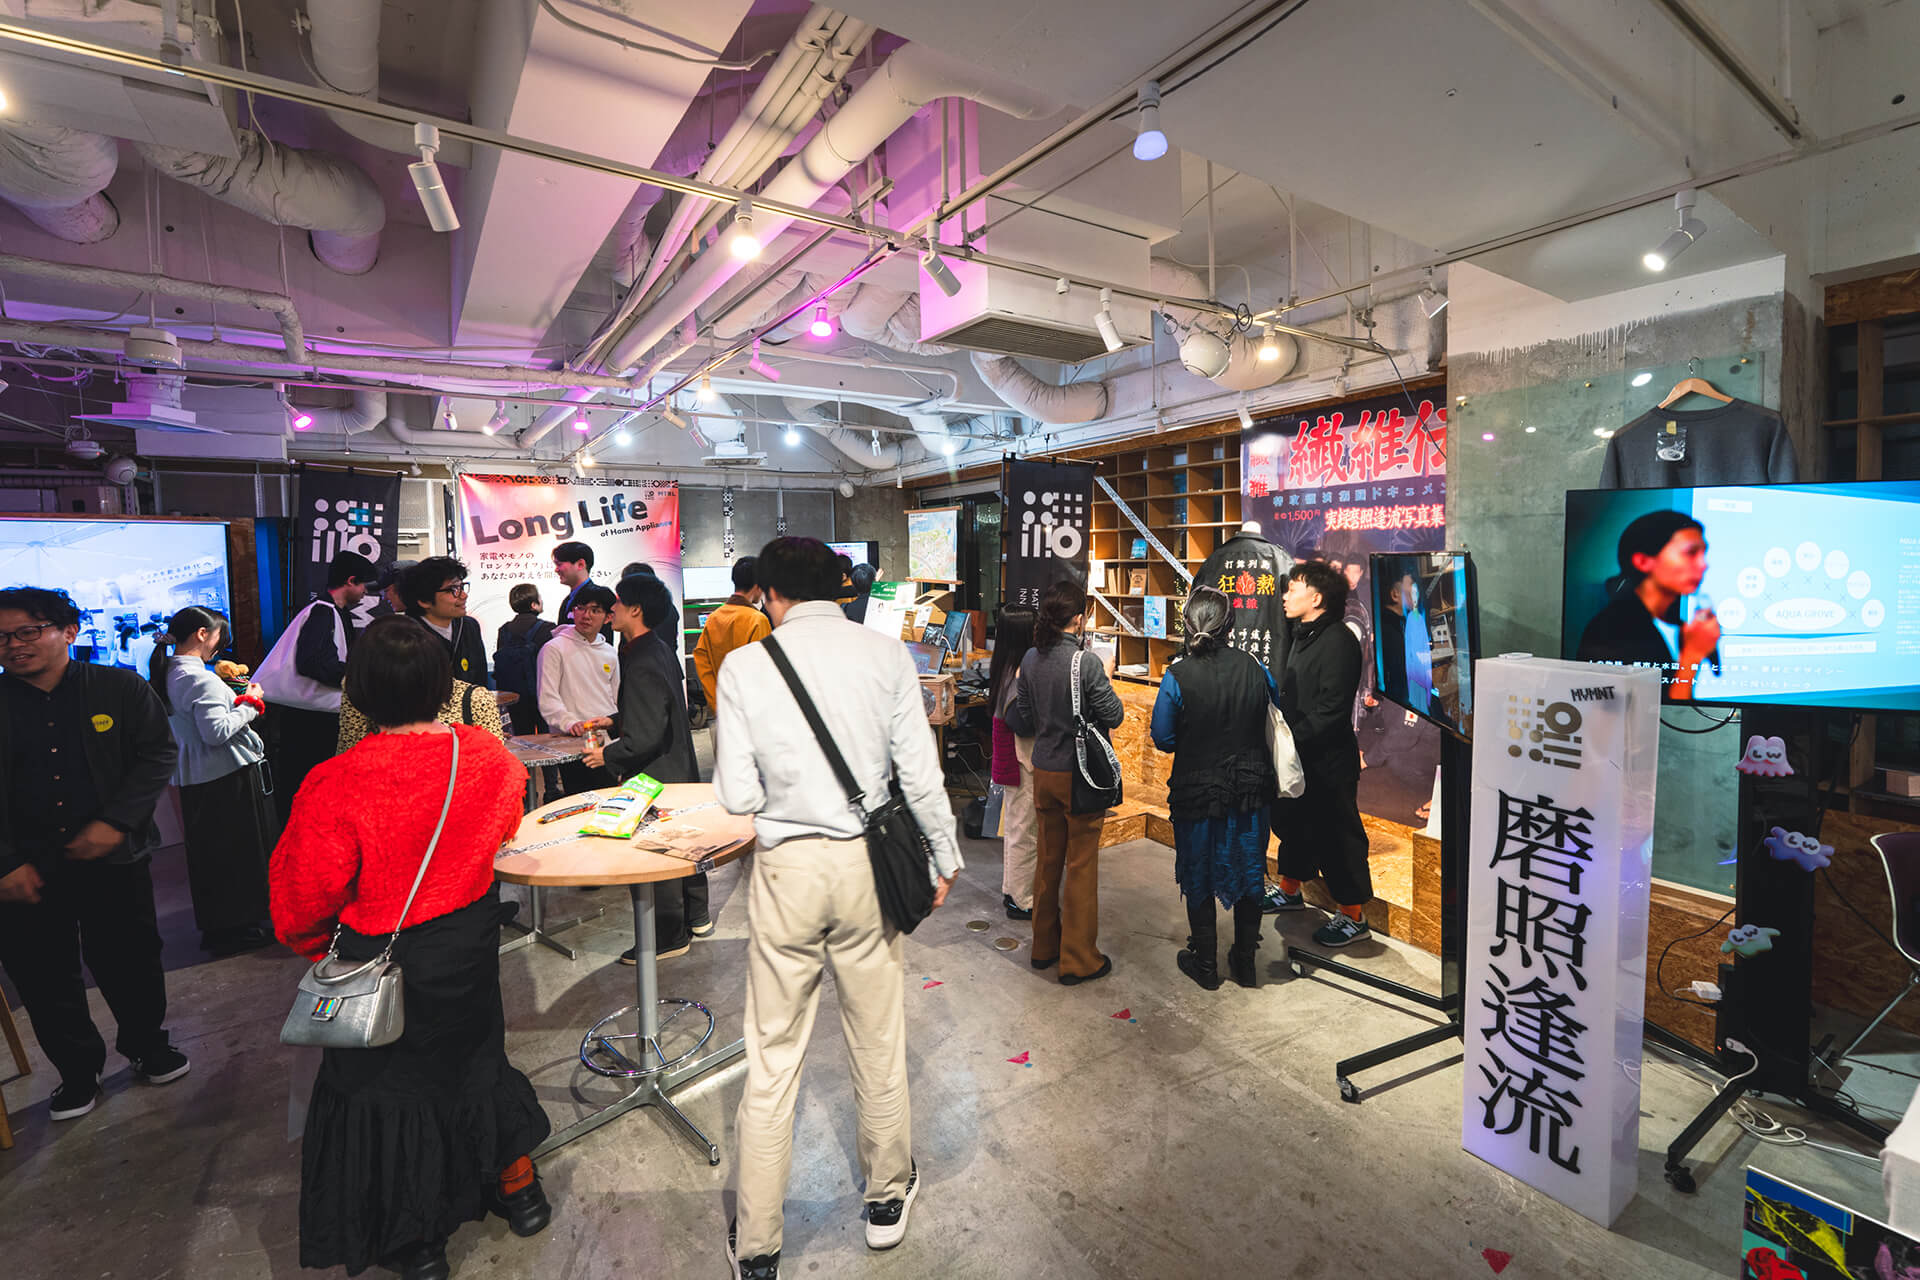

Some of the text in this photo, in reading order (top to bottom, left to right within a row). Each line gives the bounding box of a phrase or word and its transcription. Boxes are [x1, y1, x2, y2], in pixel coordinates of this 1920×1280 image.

[471, 492, 648, 545] Long Life
[600, 529, 609, 537] of
[610, 526, 634, 535] Home
[480, 551, 534, 560] 家電やモノの
[1031, 588, 1040, 610] MAT
[1776, 609, 1802, 619] AQUA
[1570, 686, 1615, 702] MVMNT
[1478, 789, 1596, 1176] 磨照逢流
